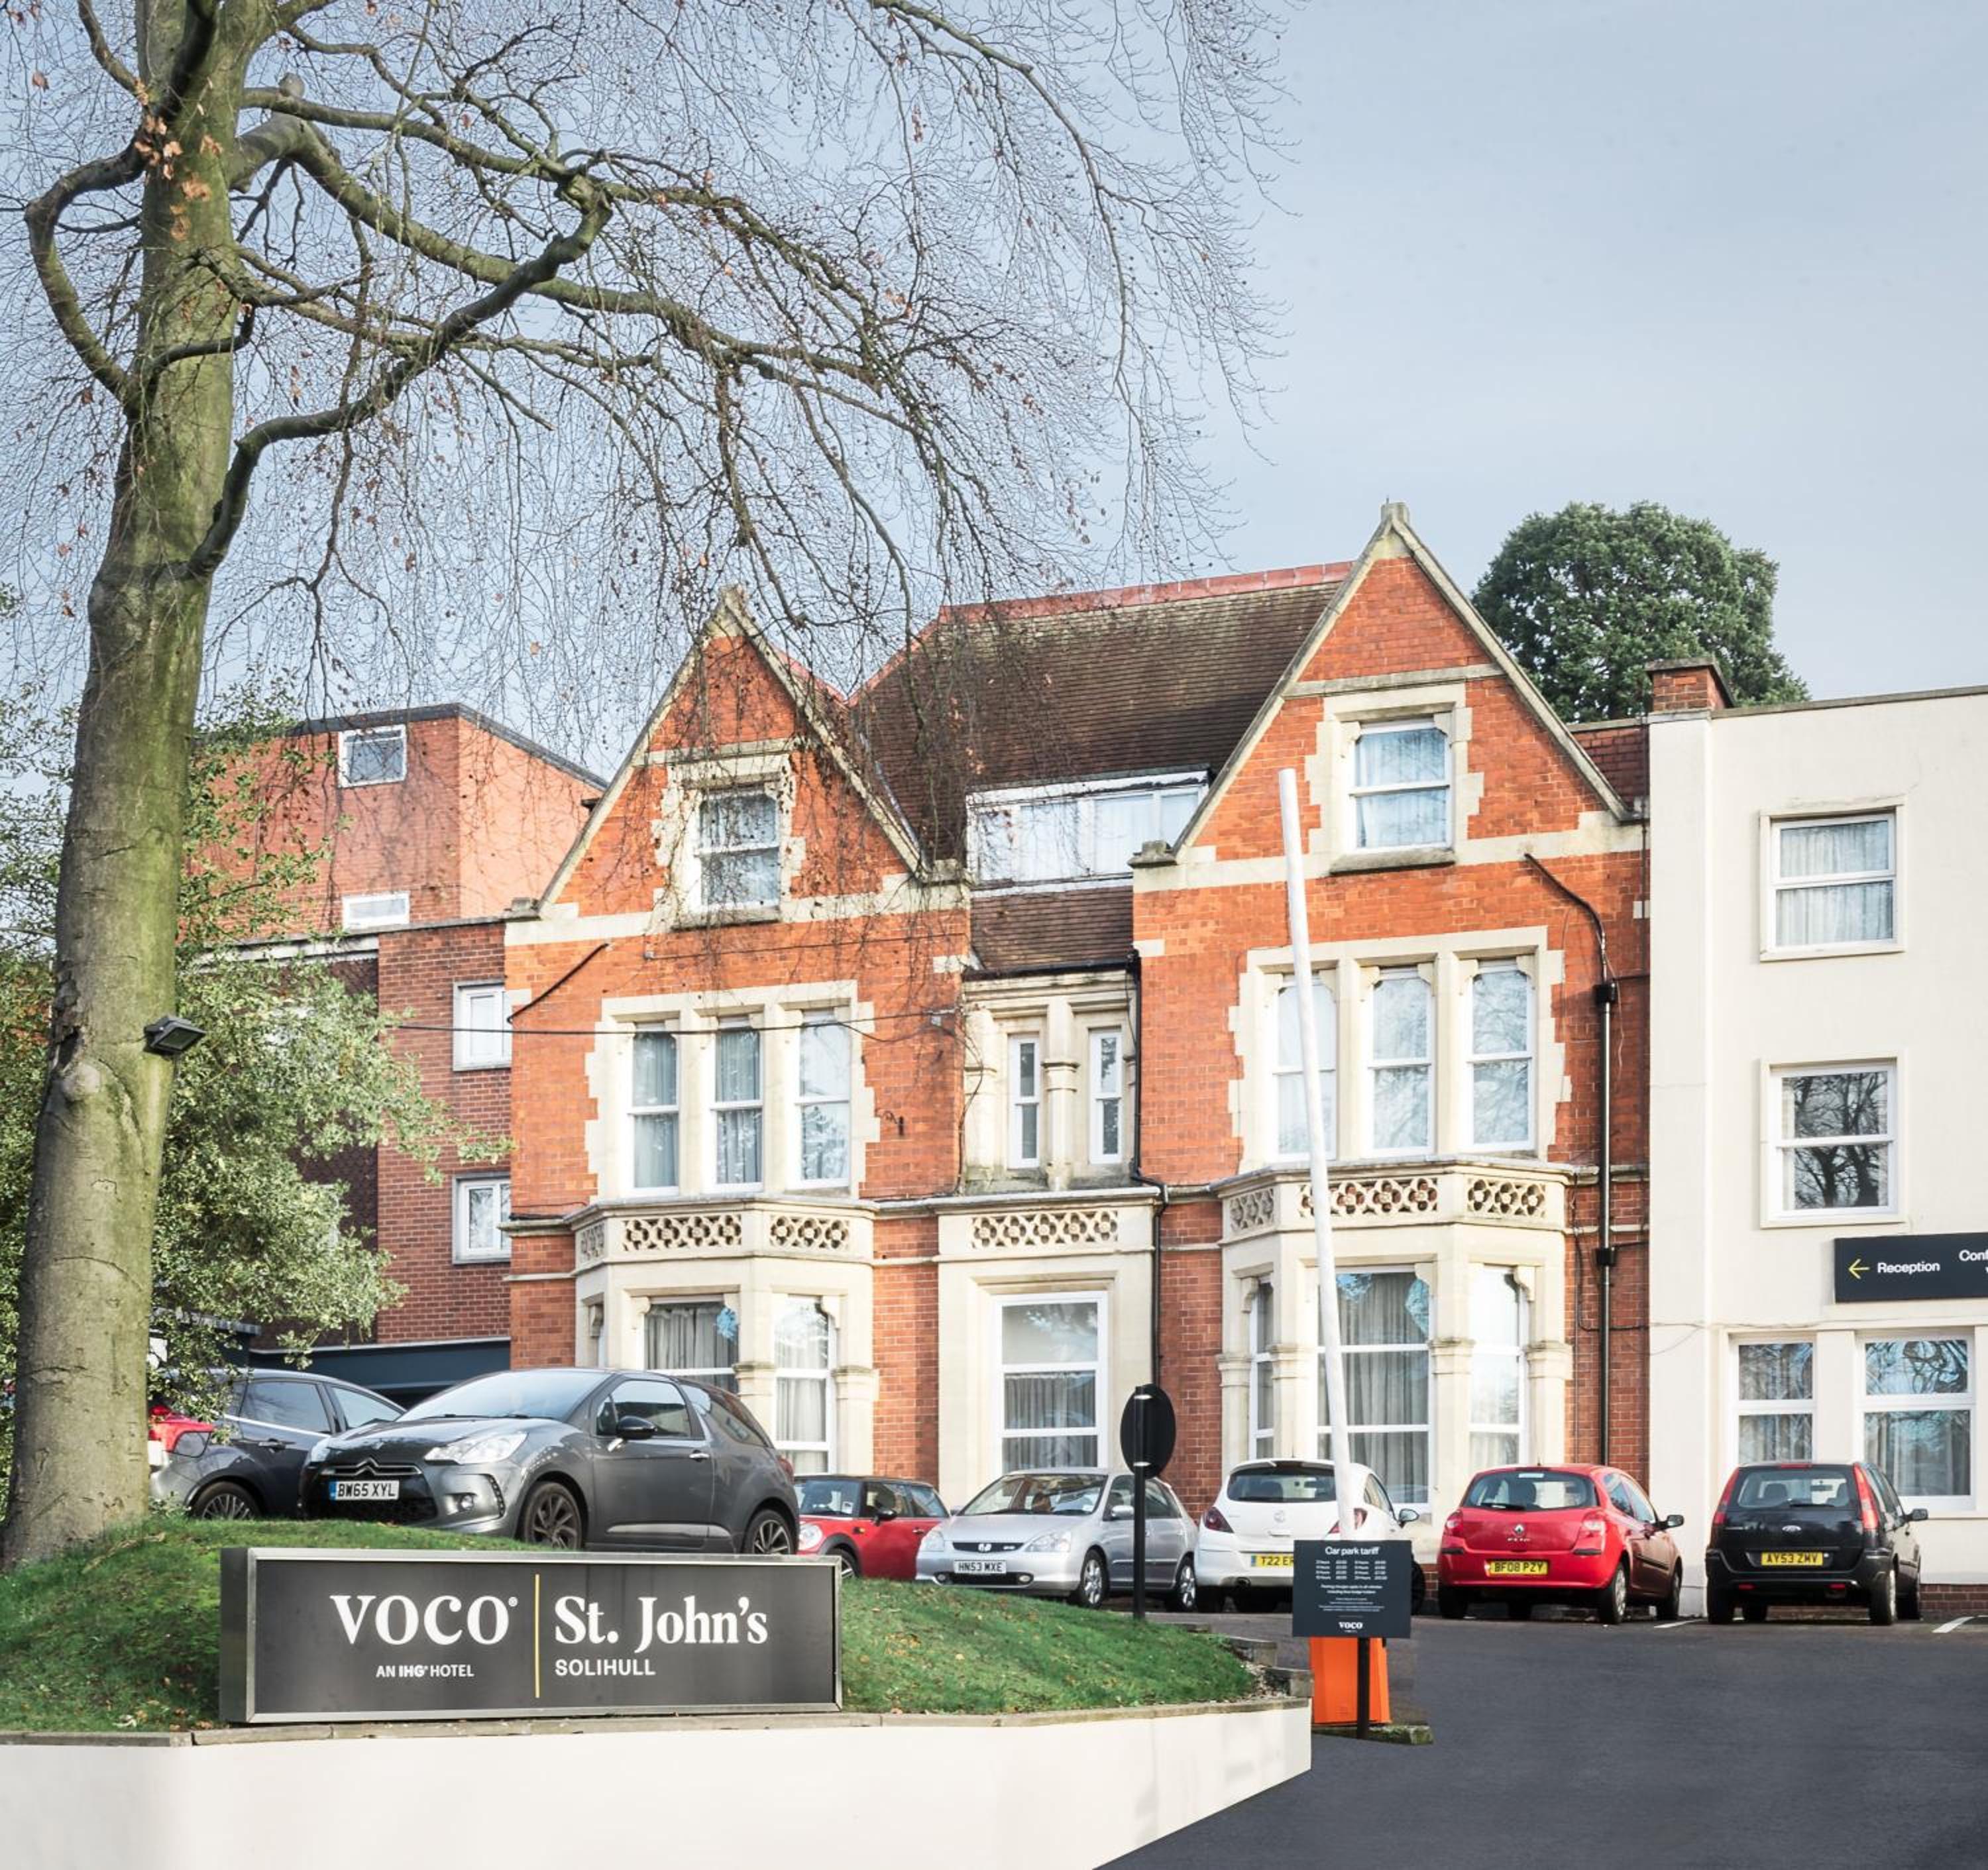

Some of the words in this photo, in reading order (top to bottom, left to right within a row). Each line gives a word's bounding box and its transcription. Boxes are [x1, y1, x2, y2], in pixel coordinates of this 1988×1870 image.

[1877, 1260, 1940, 1274] Reception
[371, 1482, 396, 1497] XYL
[1325, 1546, 1340, 1555] Car
[1341, 1547, 1359, 1557] park
[1360, 1545, 1380, 1555] tariff
[1261, 1555, 1280, 1566] T22
[1523, 1561, 1544, 1572] PZY
[555, 1596, 619, 1644] St.
[634, 1595, 768, 1653] John's
[376, 1665, 396, 1678] AN
[430, 1664, 475, 1677] HOTEL
[555, 1659, 656, 1676] SOLIHULL
